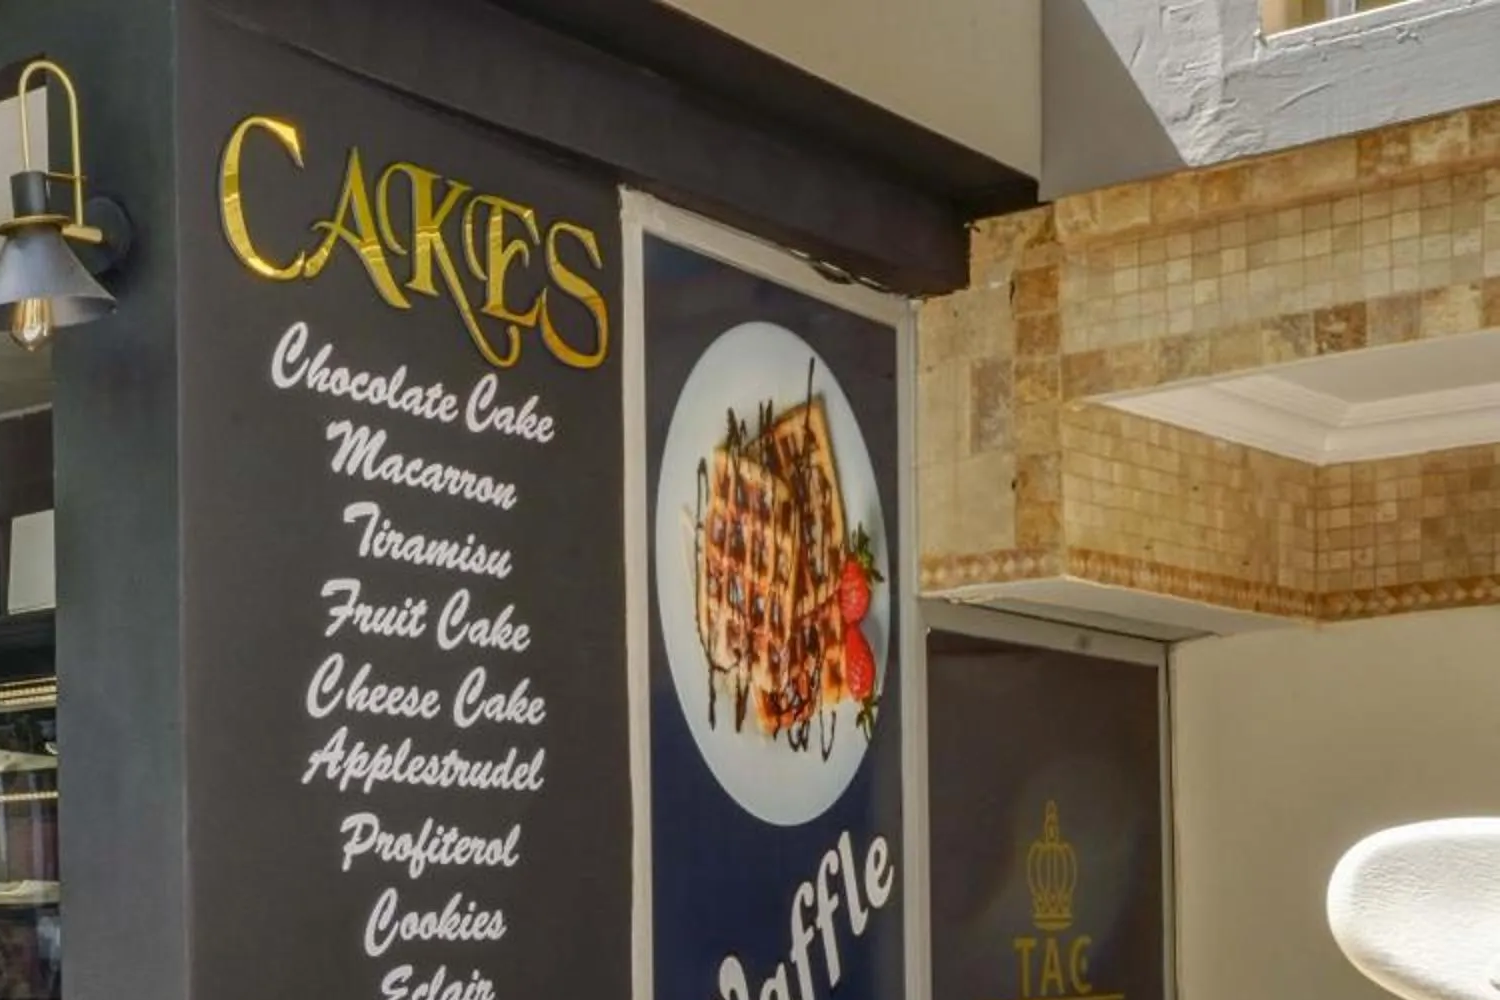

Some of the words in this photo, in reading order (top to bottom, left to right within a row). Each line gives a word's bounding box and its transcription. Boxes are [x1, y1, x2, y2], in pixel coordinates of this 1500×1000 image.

[220, 116, 608, 368] CAKES
[271, 321, 459, 422] Chocolate
[465, 372, 554, 443] Cake
[325, 420, 517, 510] Macarron
[343, 501, 513, 578] Tiramisu
[320, 578, 428, 637] Fruit
[437, 588, 531, 651] Cake
[306, 653, 441, 719] Cheese
[453, 665, 546, 729] Cake
[302, 725, 545, 794] Applestrudel
[340, 812, 521, 880] Profiterol
[364, 887, 507, 957] Cookies
[1014, 935, 1092, 998] TAC
